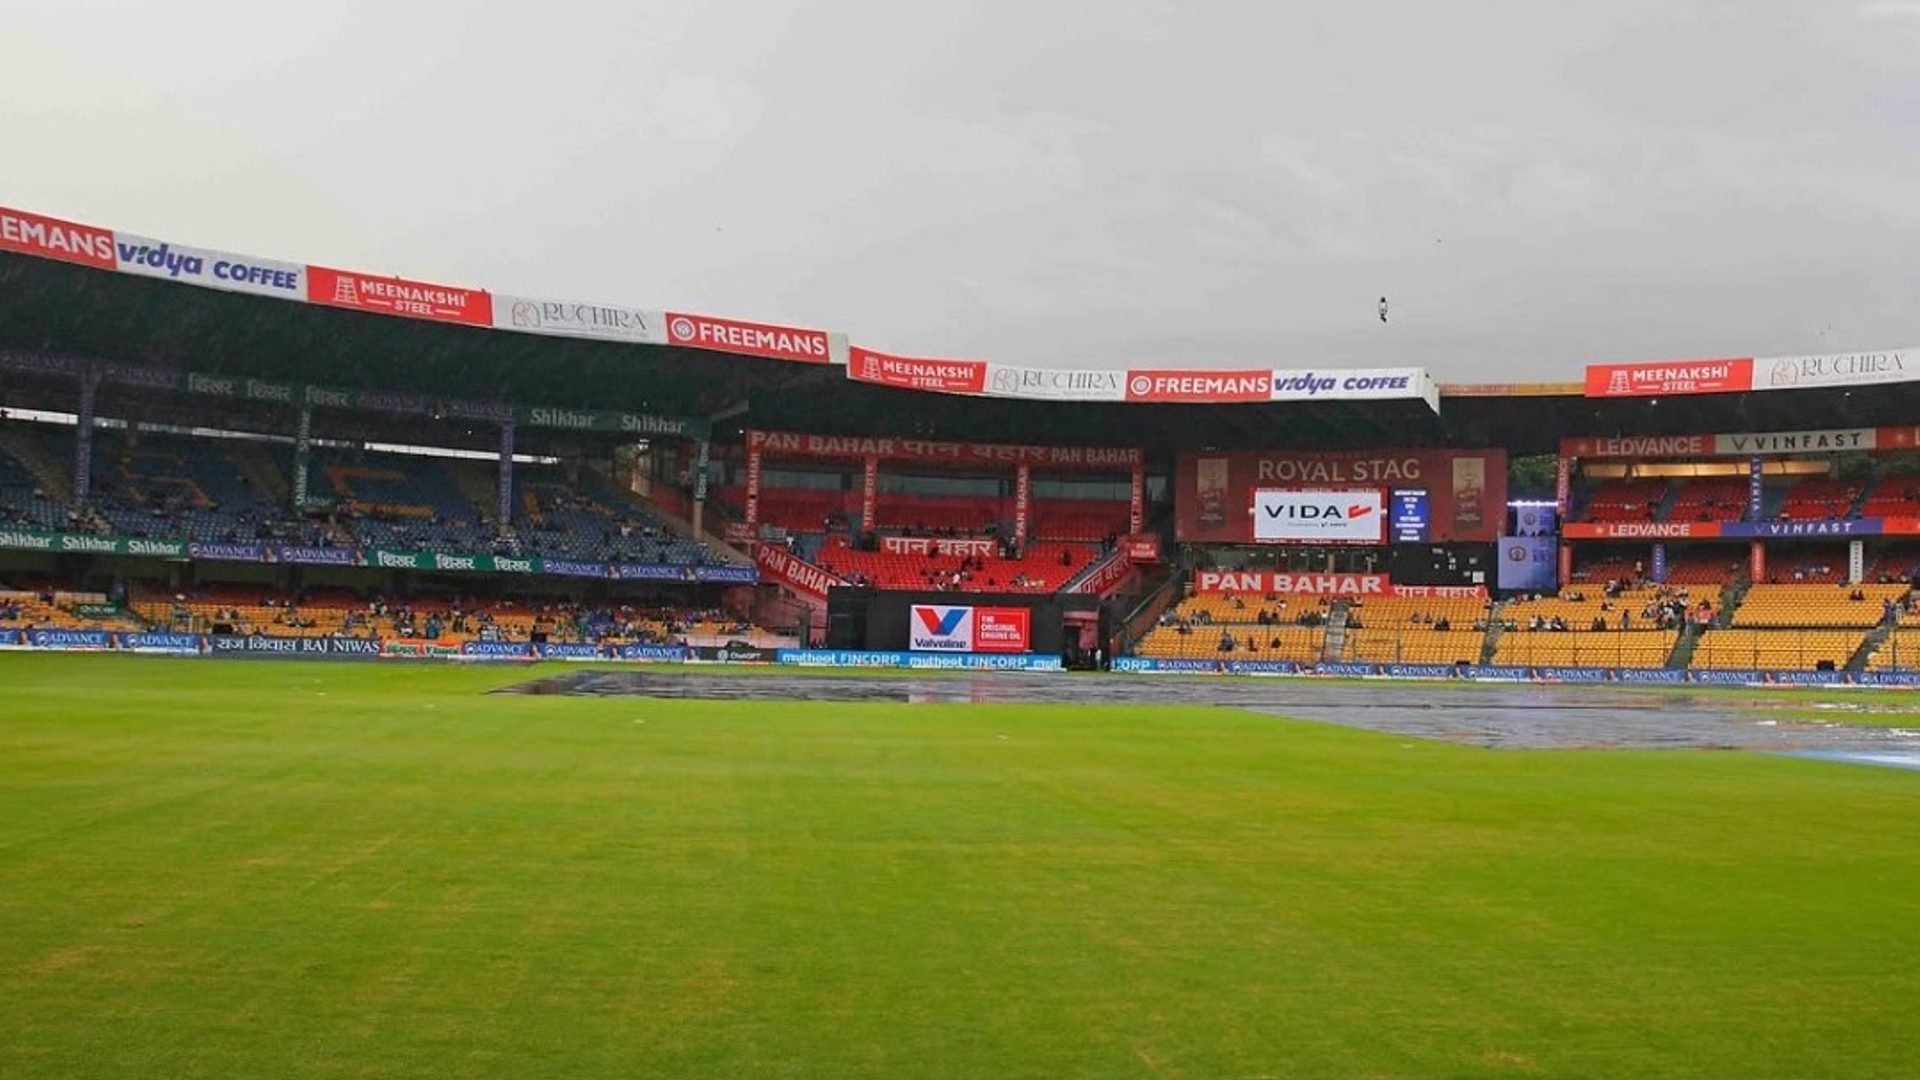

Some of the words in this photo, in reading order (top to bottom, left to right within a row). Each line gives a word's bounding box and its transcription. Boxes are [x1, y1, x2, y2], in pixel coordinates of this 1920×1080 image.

[0, 215, 113, 260] EMANS
[117, 243, 203, 277] vidya
[213, 261, 298, 290] COFFEE
[361, 281, 466, 307] MEENAKSHI
[395, 301, 434, 315] STEEL
[543, 303, 647, 330] RUCHIRA
[700, 322, 826, 356] FREEMANS
[883, 361, 973, 379] MEENAKSHI
[1801, 353, 1904, 376] RUCHIRA
[1022, 369, 1117, 390] RUCHIRA
[1633, 364, 1728, 382] MEENAKSHI
[911, 377, 945, 388] STEEL
[1155, 376, 1269, 394] FREEMANS
[1274, 372, 1336, 395] vidya
[1343, 375, 1409, 390] COFFEE
[1662, 380, 1696, 391] STEEL
[531, 408, 595, 428] Shikhar
[621, 414, 686, 434] Shikhar
[751, 432, 800, 449] PAN
[809, 435, 895, 454] BAHAR
[1596, 436, 1703, 456] LEDVANCE
[1755, 433, 1862, 449] VINFAST
[1051, 447, 1080, 462] PAN
[1258, 460, 1345, 482] ROYAL
[1352, 458, 1421, 482] STAG
[1265, 505, 1342, 519] VIDA
[1609, 523, 1690, 537] LEDVANCE
[1771, 522, 1852, 535] VINFAST
[62, 536, 118, 551] Shikhar
[128, 540, 183, 555] Shikhar
[201, 544, 257, 556] ADVANCE
[885, 537, 930, 555] पान
[936, 538, 993, 557] बहार
[296, 549, 350, 561] ADVANCE
[377, 550, 419, 568] शिखर
[436, 553, 476, 571] शिखर
[493, 555, 534, 573] शिखर
[759, 545, 787, 573] PAN
[554, 563, 600, 574] ADVANCE
[631, 566, 678, 576] ADVANCE
[706, 569, 751, 579] ADVANCE
[1201, 573, 1262, 591] PAN
[1273, 574, 1382, 594] BAHAR
[1394, 584, 1428, 598] पान
[51, 632, 102, 644] ADVANCE
[140, 635, 192, 647] ADVANCE
[915, 638, 967, 649] Valvoline
[303, 639, 329, 653] RAJ
[334, 639, 380, 653] NIWAS
[477, 644, 523, 655] ADVANCE
[636, 647, 683, 658] ADVANCE
[730, 651, 762, 661] ChatGPT
[782, 651, 836, 665] muthoot
[840, 653, 901, 665] FINCORP
[909, 654, 963, 668] muthoot
[966, 656, 1028, 669] FINCORP
[1168, 661, 1213, 671] ADVANCE
[1244, 662, 1288, 672] ADVANCE
[1327, 665, 1371, 674] ADVANCE
[1402, 667, 1449, 677] ADVANCE
[1477, 668, 1524, 678] ADVANCE
[1555, 669, 1603, 680] ADVANCE
[1633, 670, 1680, 680] ADVANCE
[1710, 672, 1758, 682] ADVANCE
[1789, 673, 1838, 682] ADVANCE
